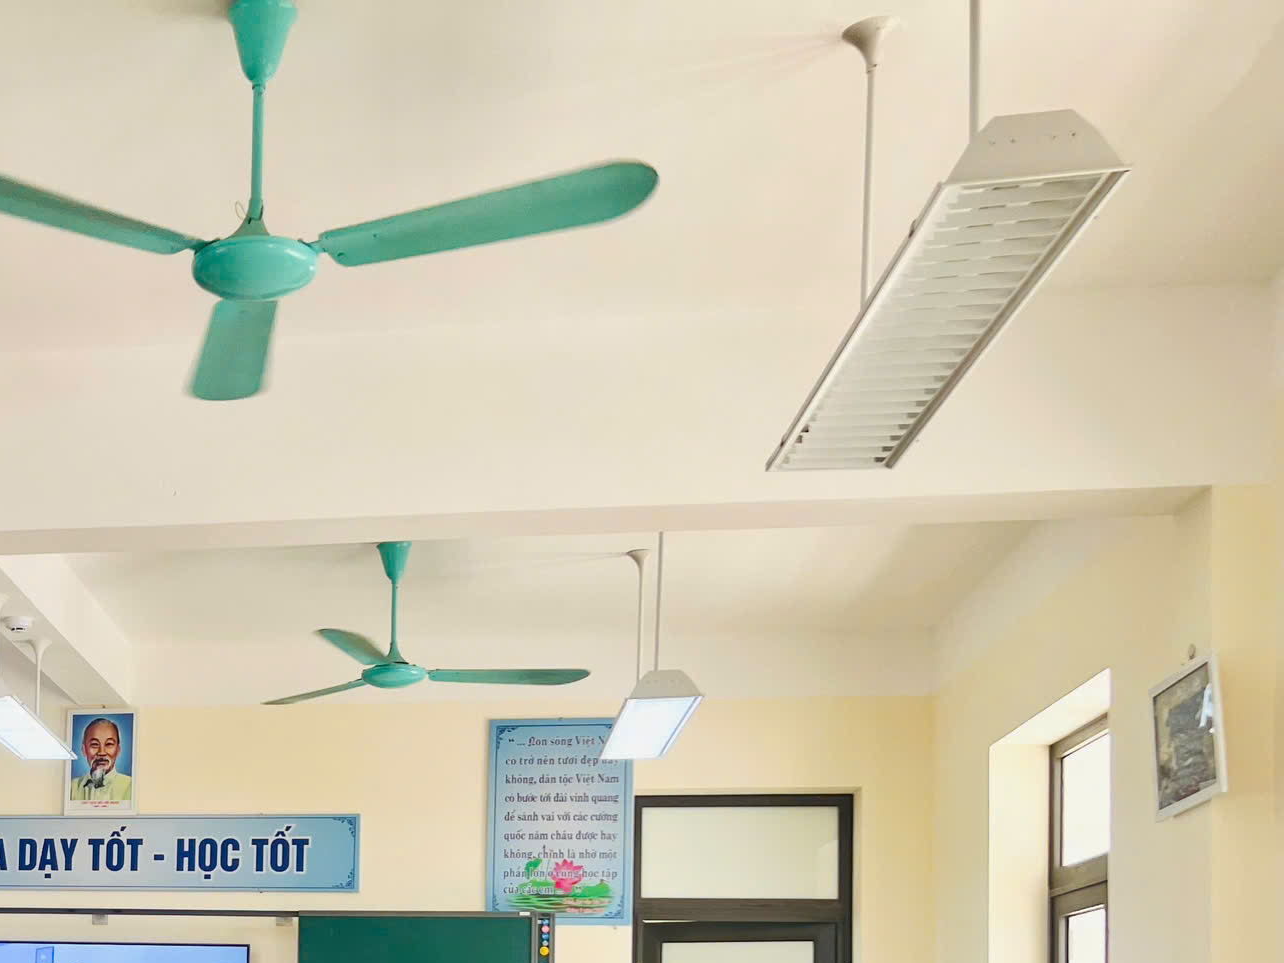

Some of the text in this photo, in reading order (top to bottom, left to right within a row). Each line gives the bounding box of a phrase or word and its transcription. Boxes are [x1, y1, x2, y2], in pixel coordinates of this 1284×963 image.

[597, 773, 619, 784] Nam
[591, 794, 619, 804] quang
[541, 812, 555, 821] vai
[600, 830, 617, 841] hay
[18, 838, 78, 878] DẠY
[88, 826, 144, 871] TỐT
[176, 838, 240, 879] HỌC
[251, 825, 310, 872] TỐT
